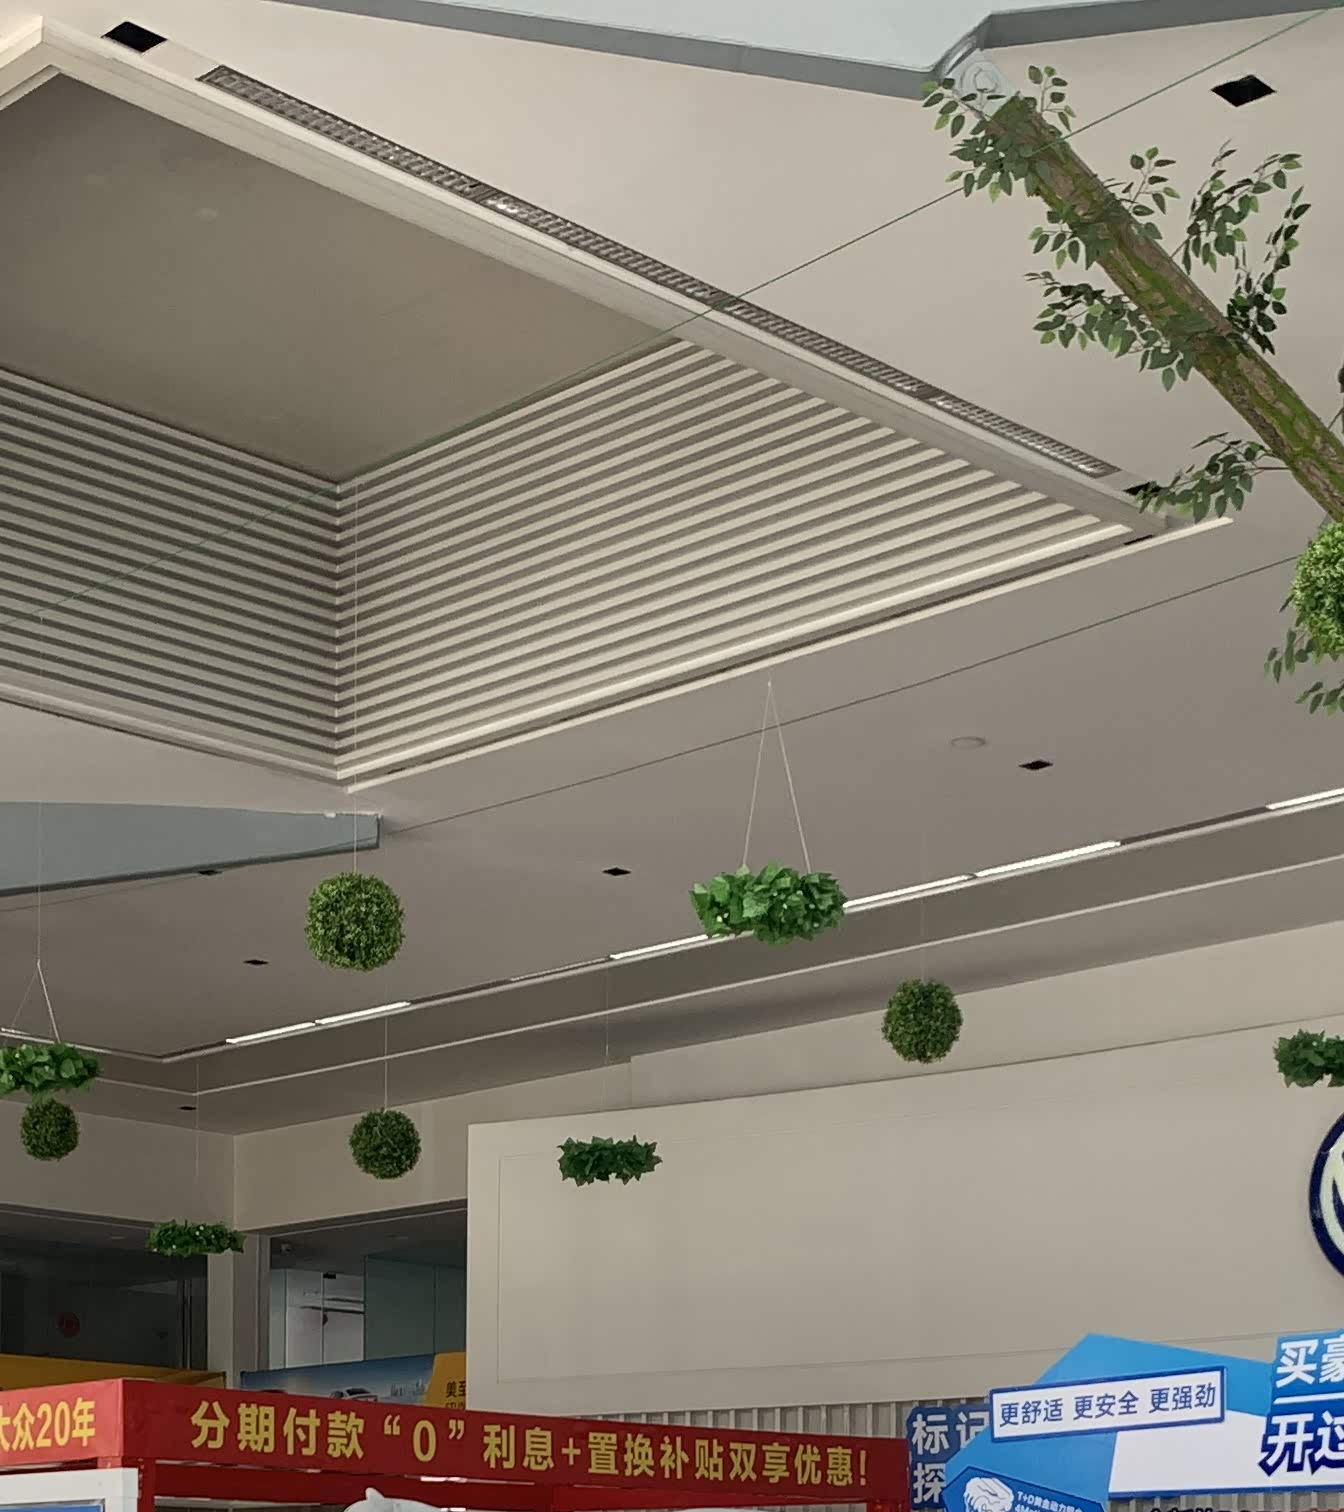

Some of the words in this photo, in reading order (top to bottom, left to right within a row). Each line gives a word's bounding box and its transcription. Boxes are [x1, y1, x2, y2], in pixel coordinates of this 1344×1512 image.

[999, 1398, 1064, 1428] 更舒适
[1073, 1390, 1139, 1421] 更安全
[1148, 1382, 1217, 1413] 更强劲
